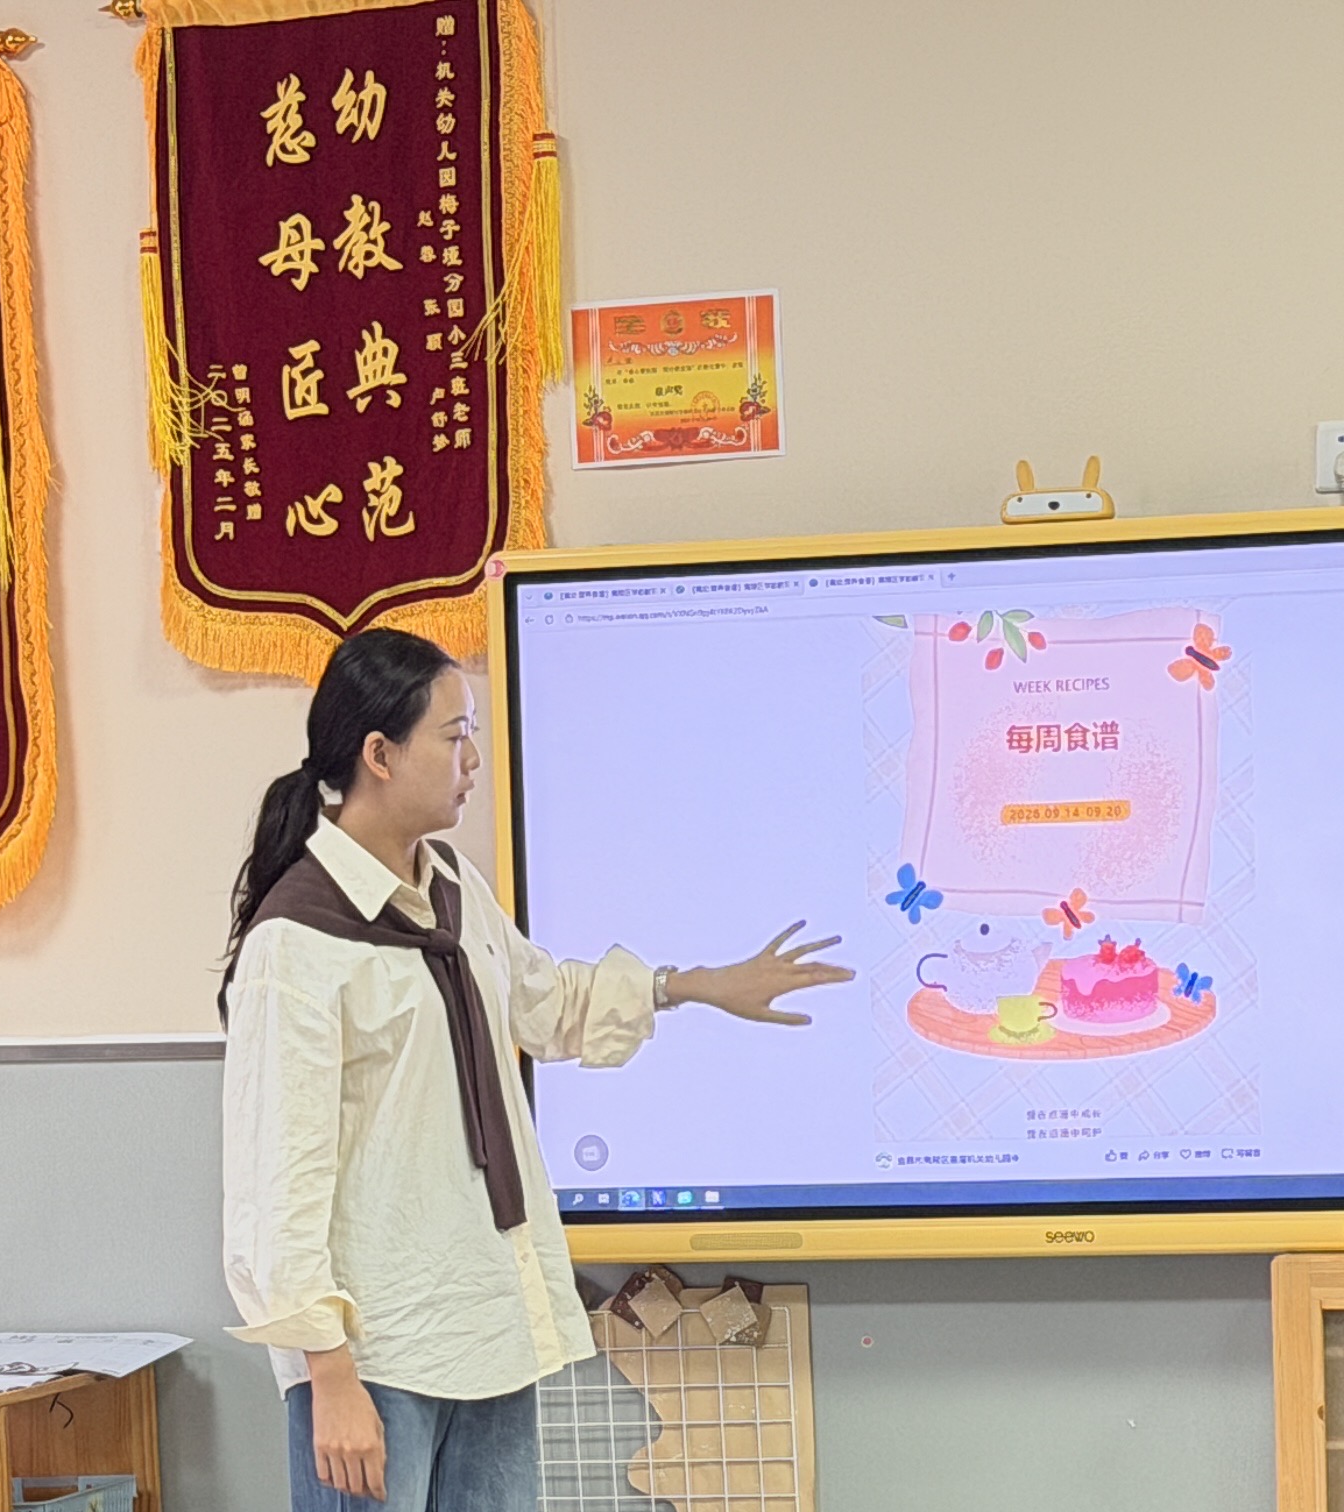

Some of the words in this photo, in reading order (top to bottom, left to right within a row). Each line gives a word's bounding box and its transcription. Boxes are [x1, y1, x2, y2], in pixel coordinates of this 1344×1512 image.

[255, 68, 348, 537] 慈母匠心
[329, 68, 416, 542] 幼教典范
[1013, 679, 1051, 693] WEEK
[1055, 677, 1110, 693] RECIPES
[1006, 721, 1121, 754] 每周食谱
[1044, 1228, 1097, 1245] seewo
